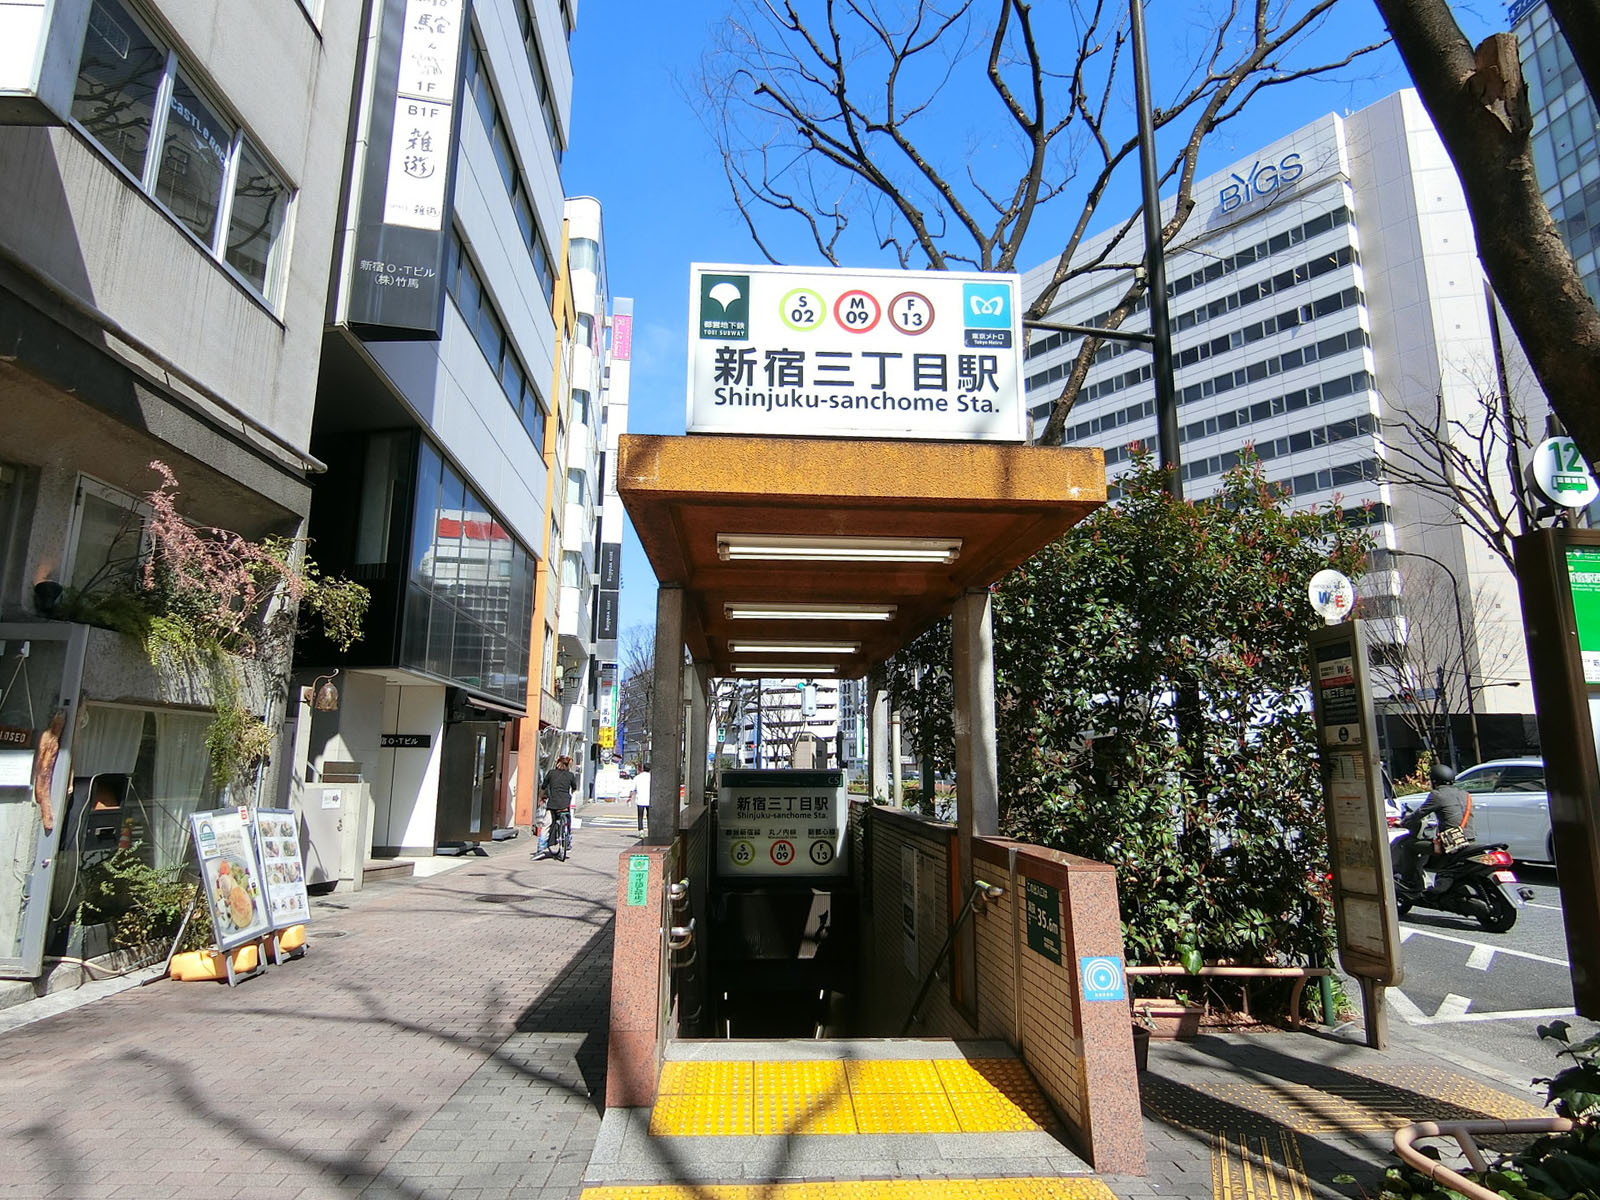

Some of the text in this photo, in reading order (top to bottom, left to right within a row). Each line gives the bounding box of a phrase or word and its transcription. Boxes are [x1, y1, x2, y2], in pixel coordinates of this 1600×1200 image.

[417, 81, 436, 92] 1F
[408, 105, 439, 118] B1F
[1220, 153, 1303, 214] BYGS
[798, 296, 808, 308] S
[850, 297, 865, 309] M
[907, 299, 915, 311] F
[791, 309, 814, 323] 02
[846, 310, 869, 324] 09
[902, 312, 923, 326] 13
[971, 333, 1005, 341] 東京メトロ
[714, 346, 999, 393] 新宿三丁目駅
[714, 386, 1000, 413] Shinjuku-sanchome Sta.
[1547, 442, 1583, 472] 12
[737, 796, 829, 811] 新宿三丁目駅
[737, 811, 828, 821] Shinjuku-sanchome Sta.
[740, 844, 746, 852] S
[736, 852, 749, 861] 02
[775, 852, 789, 861] 09
[816, 851, 828, 860] 13
